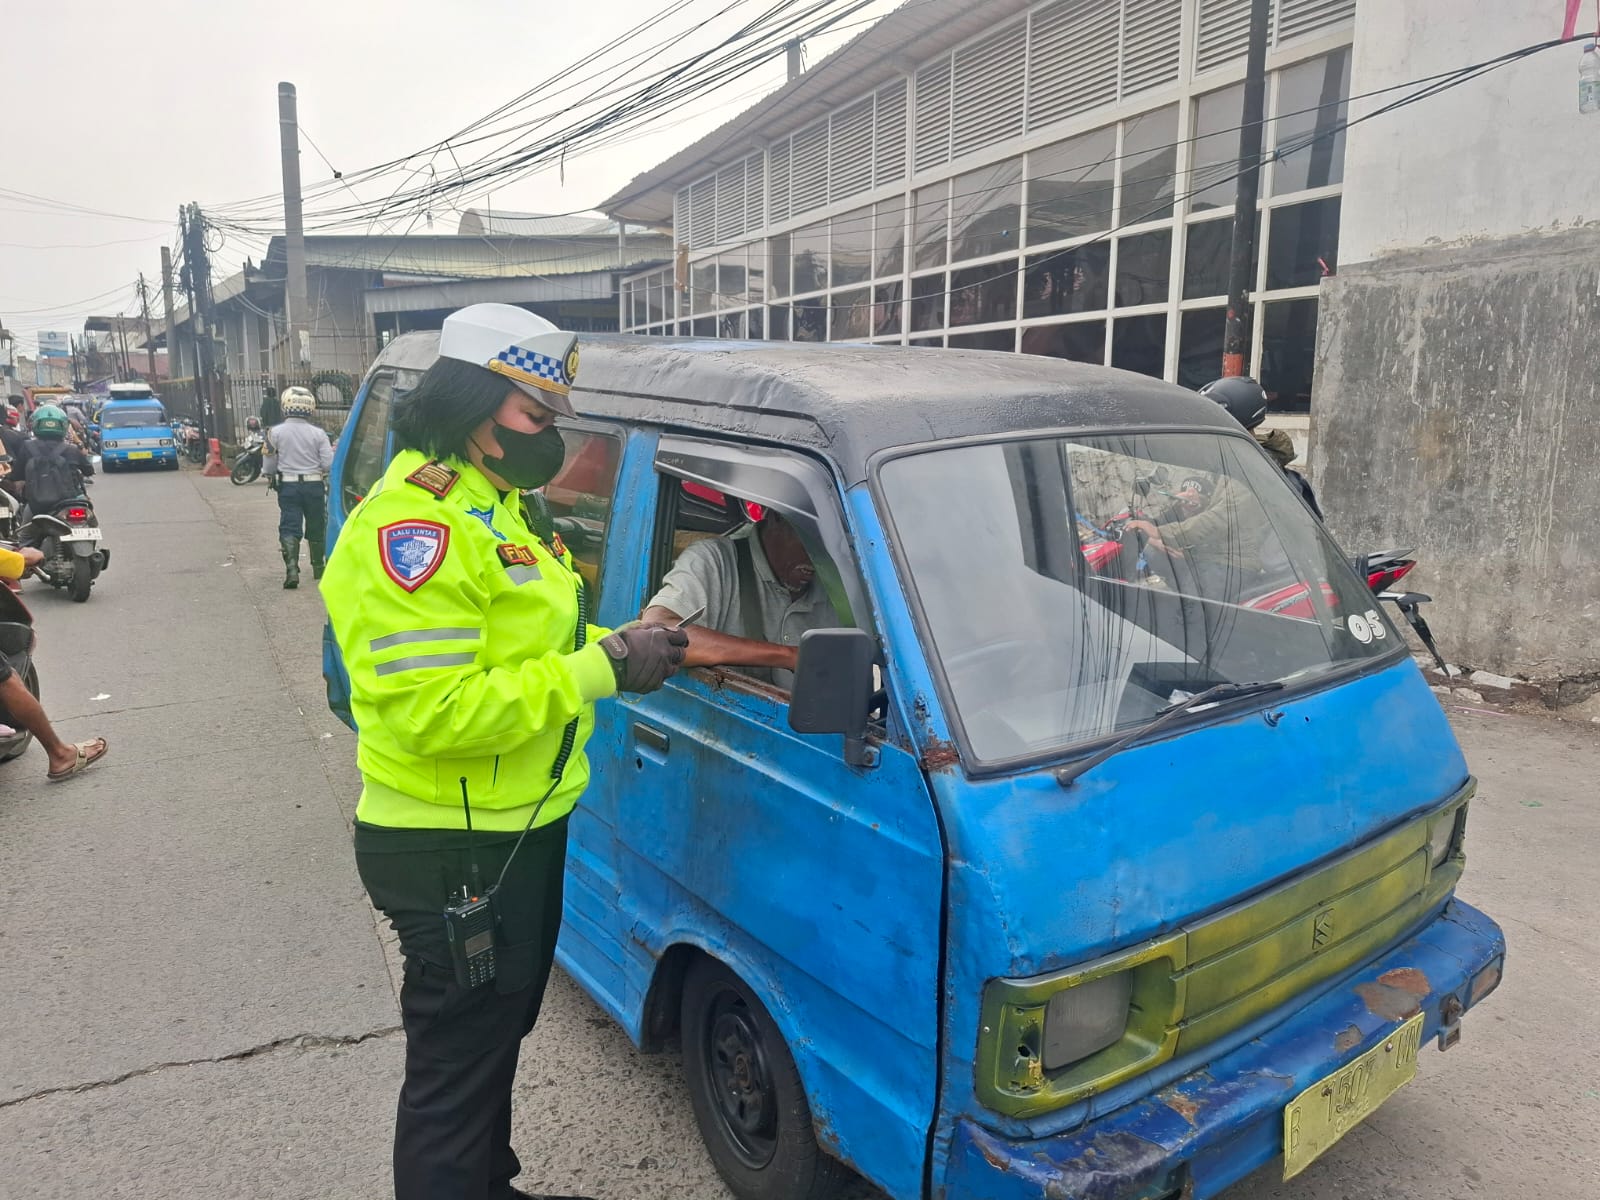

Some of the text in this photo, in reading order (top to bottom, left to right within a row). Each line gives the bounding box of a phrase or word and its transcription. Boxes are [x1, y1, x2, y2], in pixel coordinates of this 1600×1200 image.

[392, 528, 437, 537] LALU LINTAS
[1348, 609, 1386, 644] 05
[1290, 1105, 1302, 1154] B
